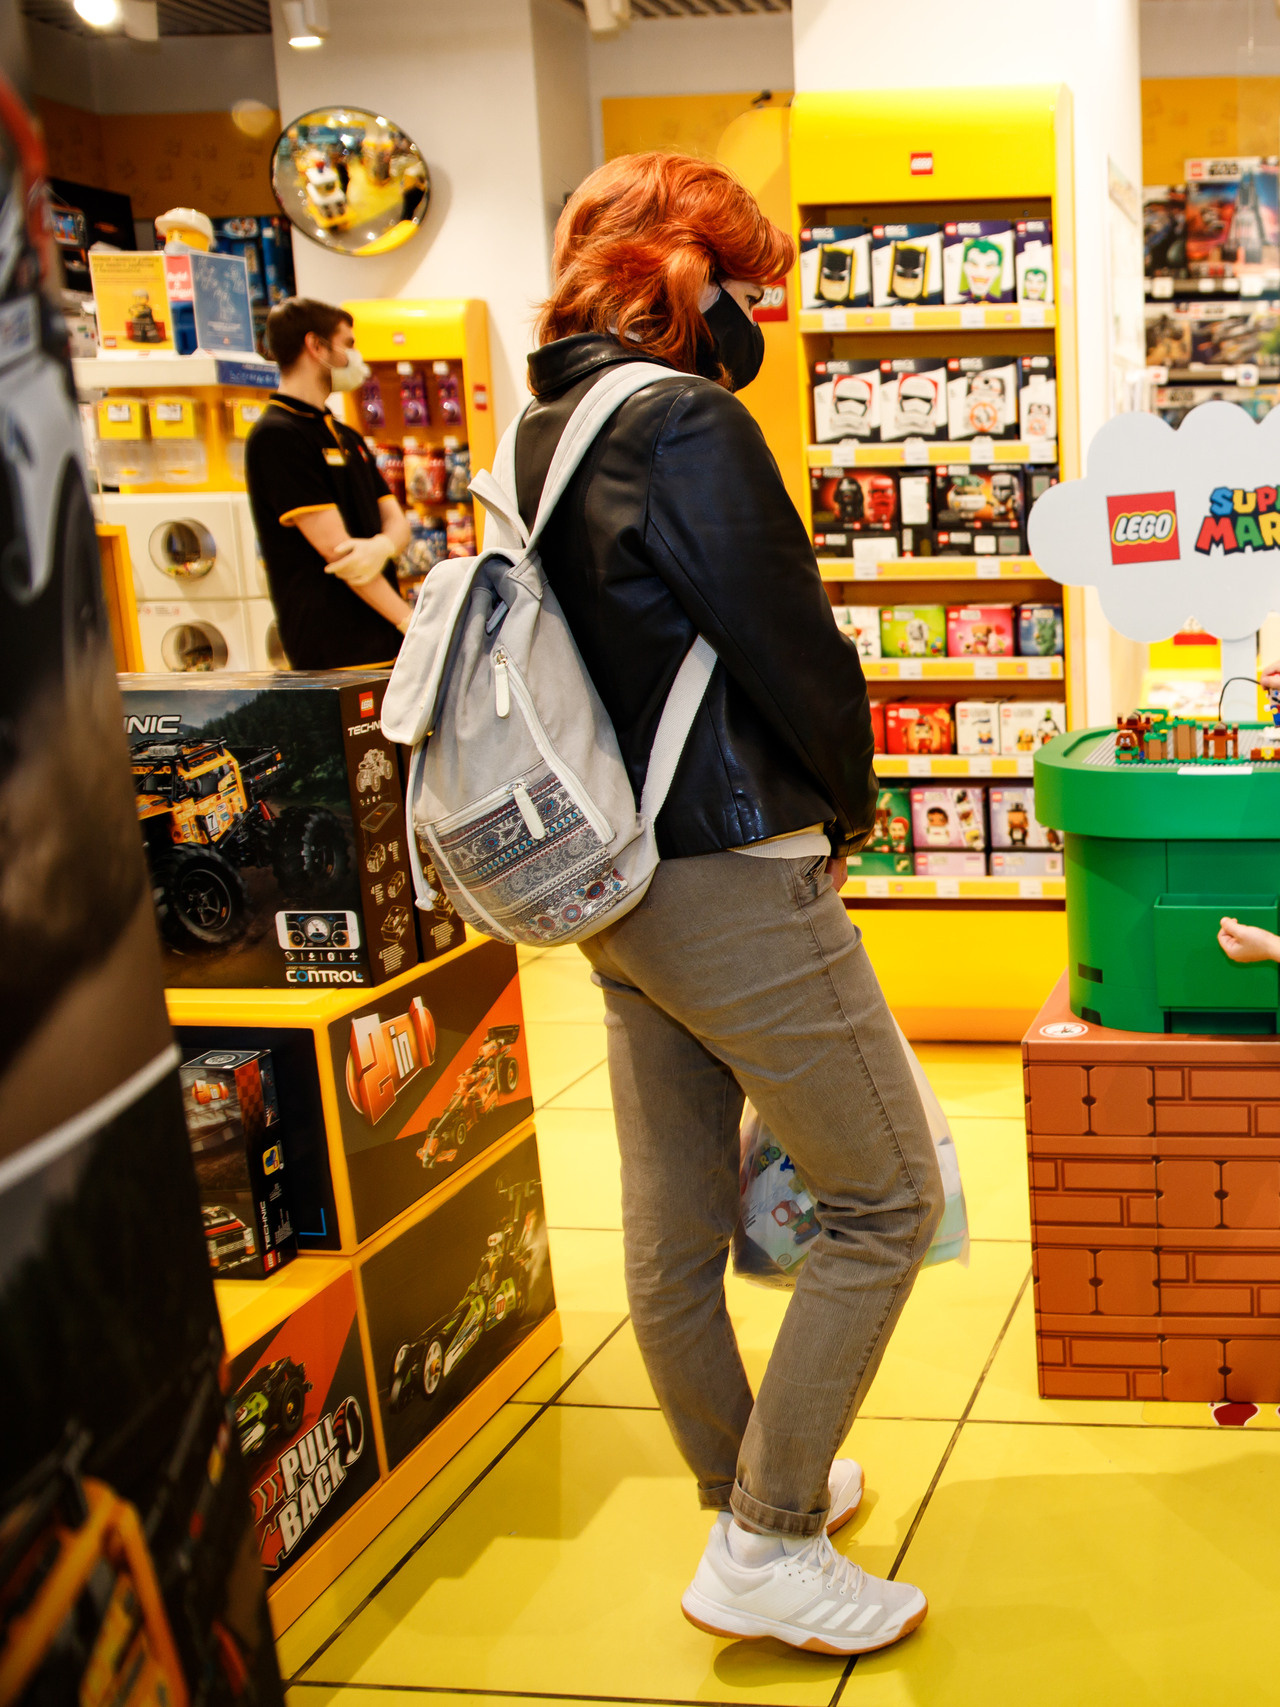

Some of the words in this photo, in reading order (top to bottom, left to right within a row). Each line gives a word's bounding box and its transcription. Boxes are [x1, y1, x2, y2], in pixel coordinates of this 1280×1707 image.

[1113, 511, 1175, 545] LEGO
[124, 715, 181, 734] NIC
[348, 720, 381, 737] TECHN
[207, 814, 214, 829] 7
[350, 1012, 397, 1126] 2
[389, 1025, 414, 1079] in
[260, 1201, 271, 1250] TECHNIC
[280, 1415, 339, 1500] PULL
[278, 1447, 345, 1553] BACK
